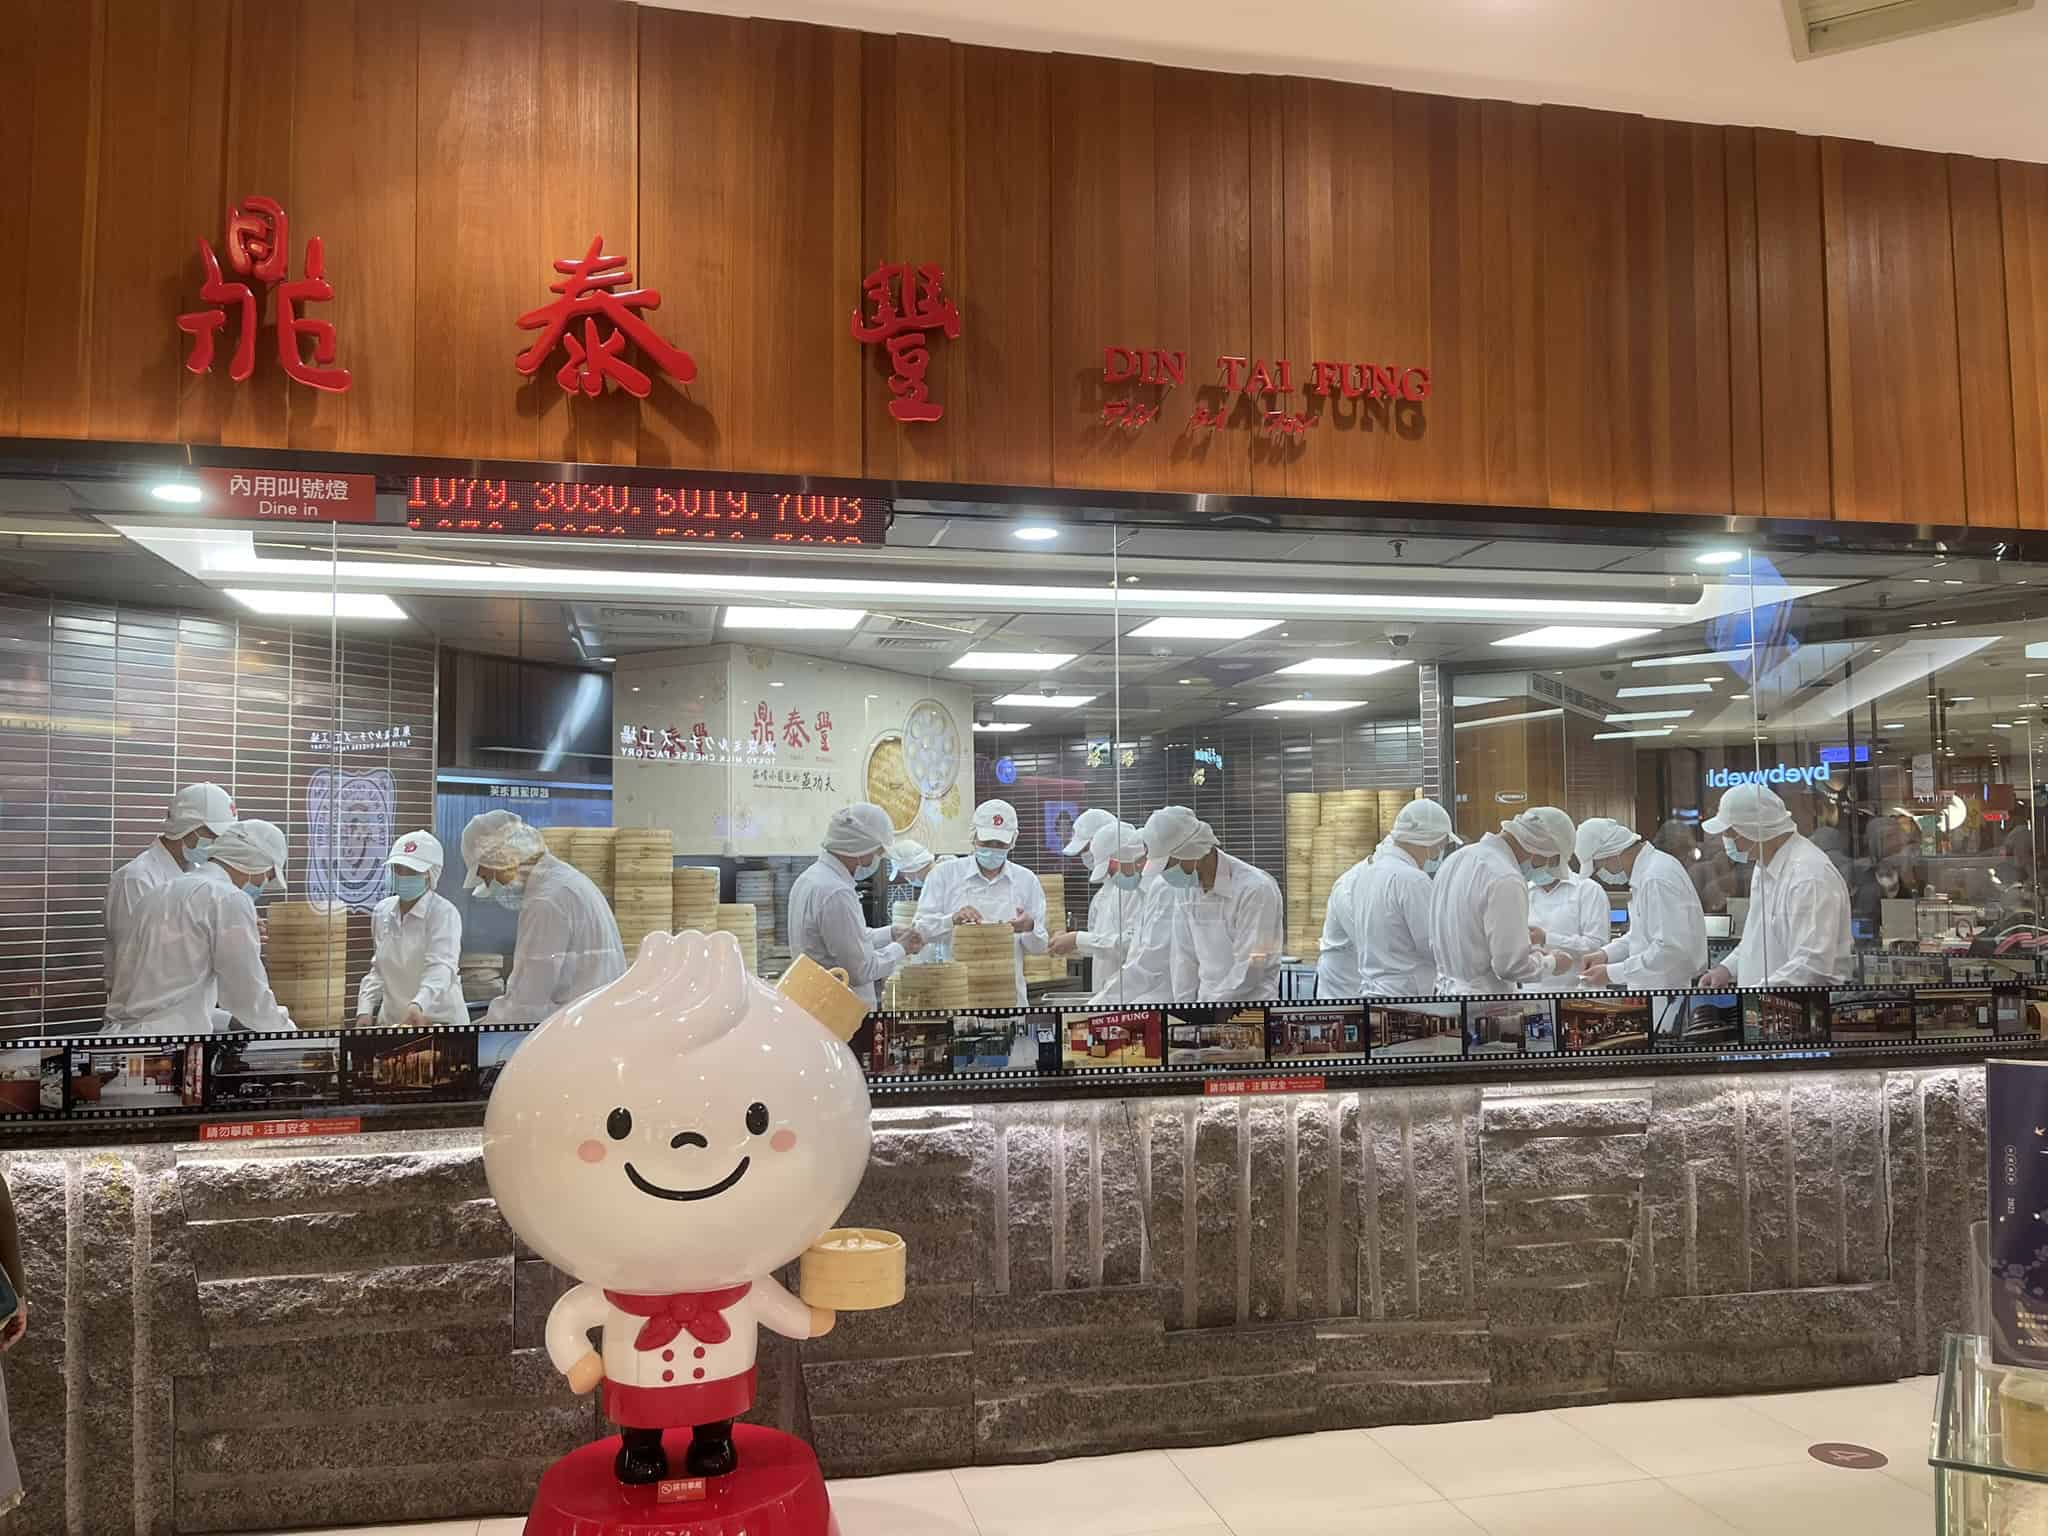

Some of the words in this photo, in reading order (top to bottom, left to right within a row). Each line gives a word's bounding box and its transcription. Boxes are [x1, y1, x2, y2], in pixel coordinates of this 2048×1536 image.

[177, 195, 960, 423] 鼎泰豐
[1104, 347, 1186, 385] DIN
[1217, 355, 1294, 393] TAI
[1312, 361, 1432, 401] FUNG
[259, 501, 297, 515] Dine
[304, 503, 318, 516] in
[1121, 1011, 1150, 1023] FUNG
